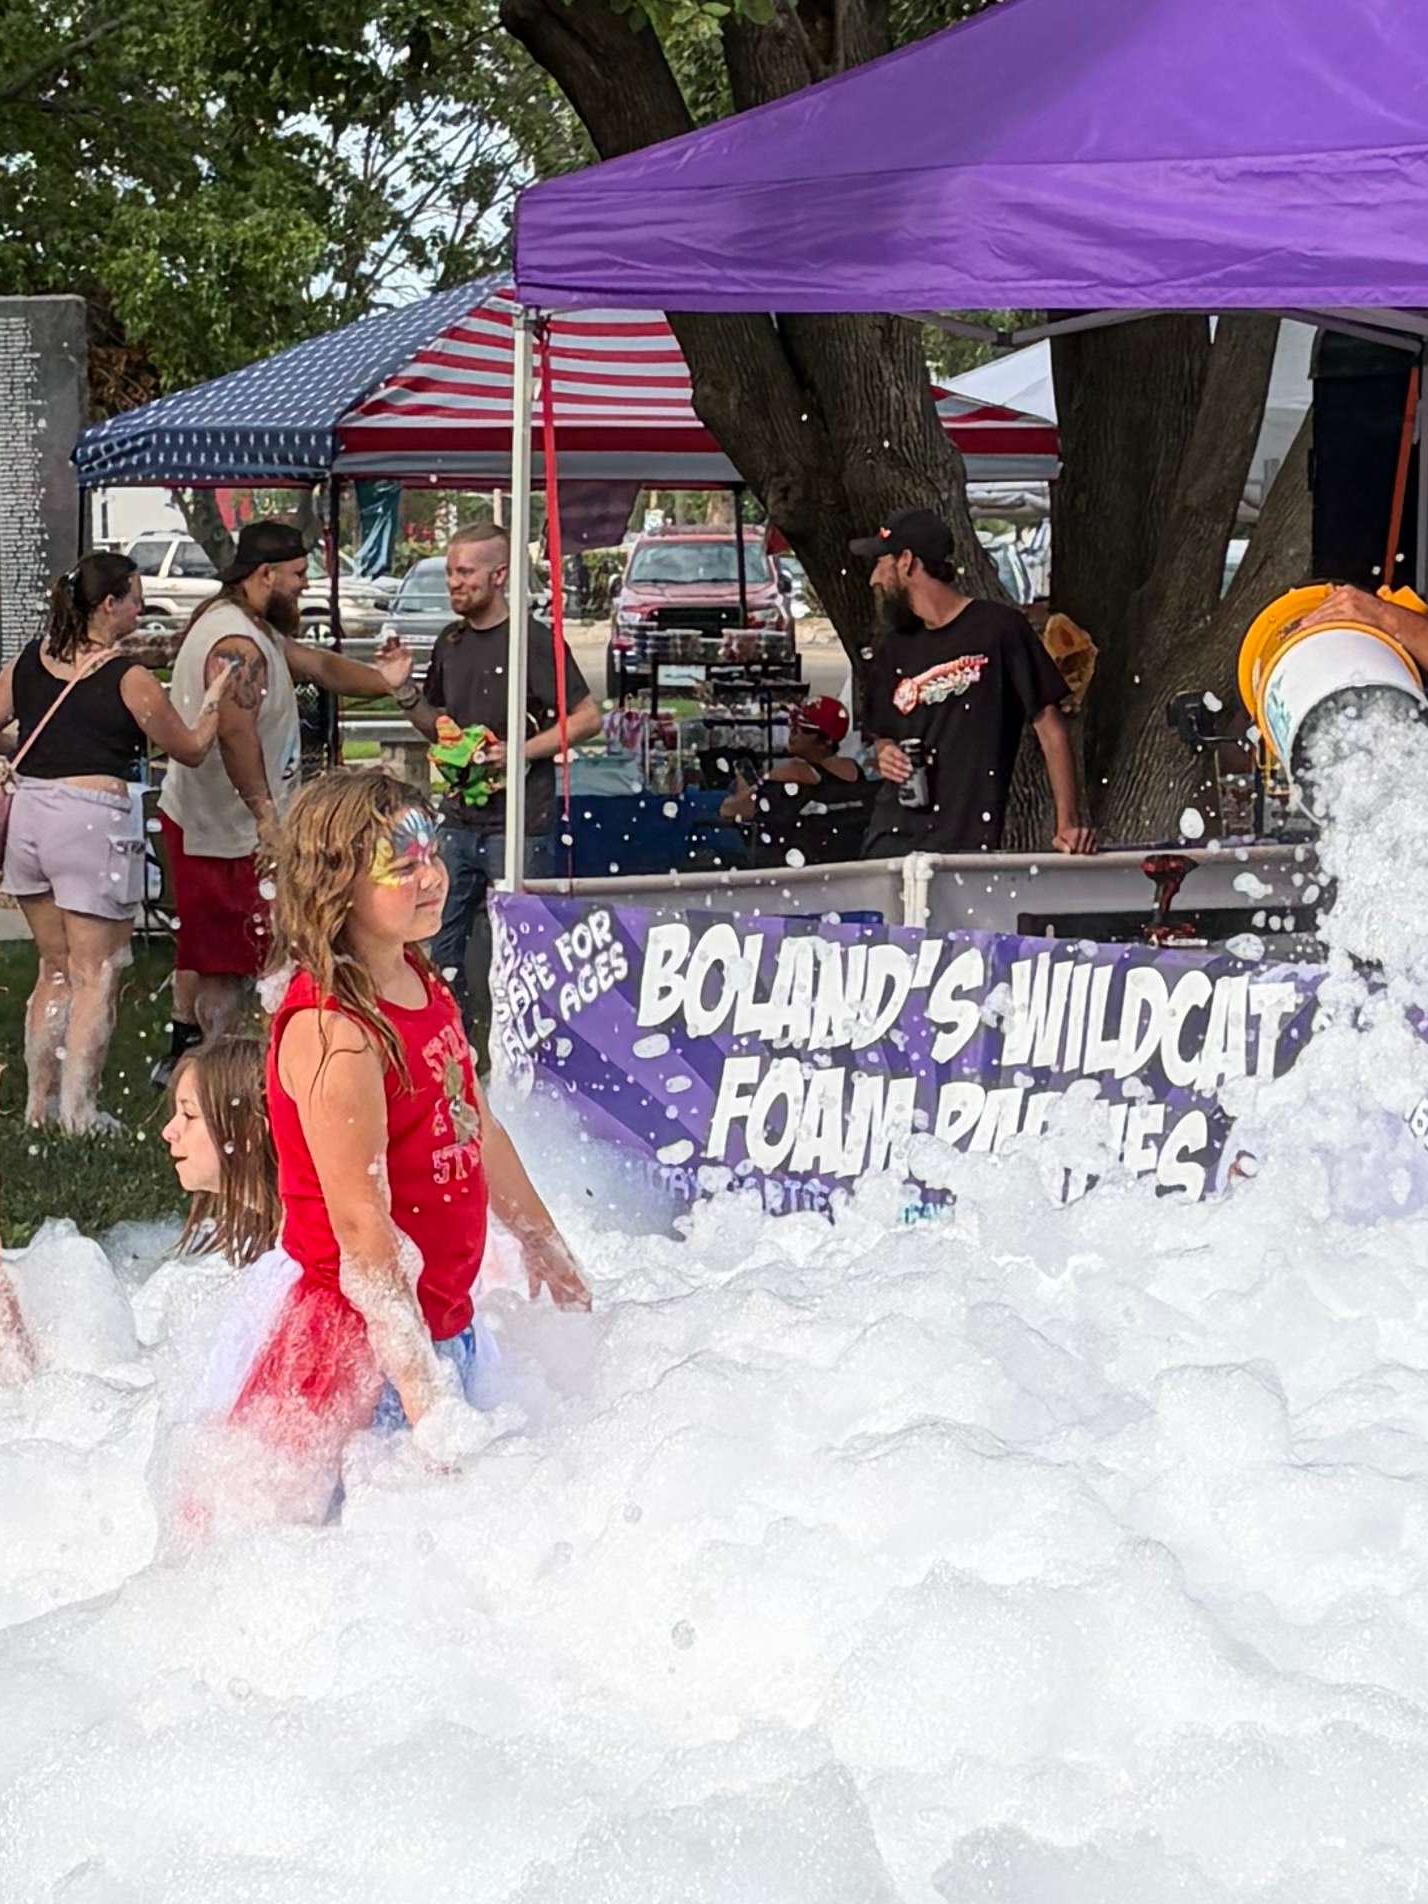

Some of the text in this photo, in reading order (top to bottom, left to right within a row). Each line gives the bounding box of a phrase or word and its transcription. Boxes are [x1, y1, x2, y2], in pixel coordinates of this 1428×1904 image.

[555, 909, 612, 973] FOR
[502, 1003, 557, 1068] ALL
[558, 941, 629, 1022] AGES
[636, 922, 985, 1064] BOLAND'S
[1001, 951, 1296, 1091] WILDCAT
[706, 1054, 917, 1180] FOAM
